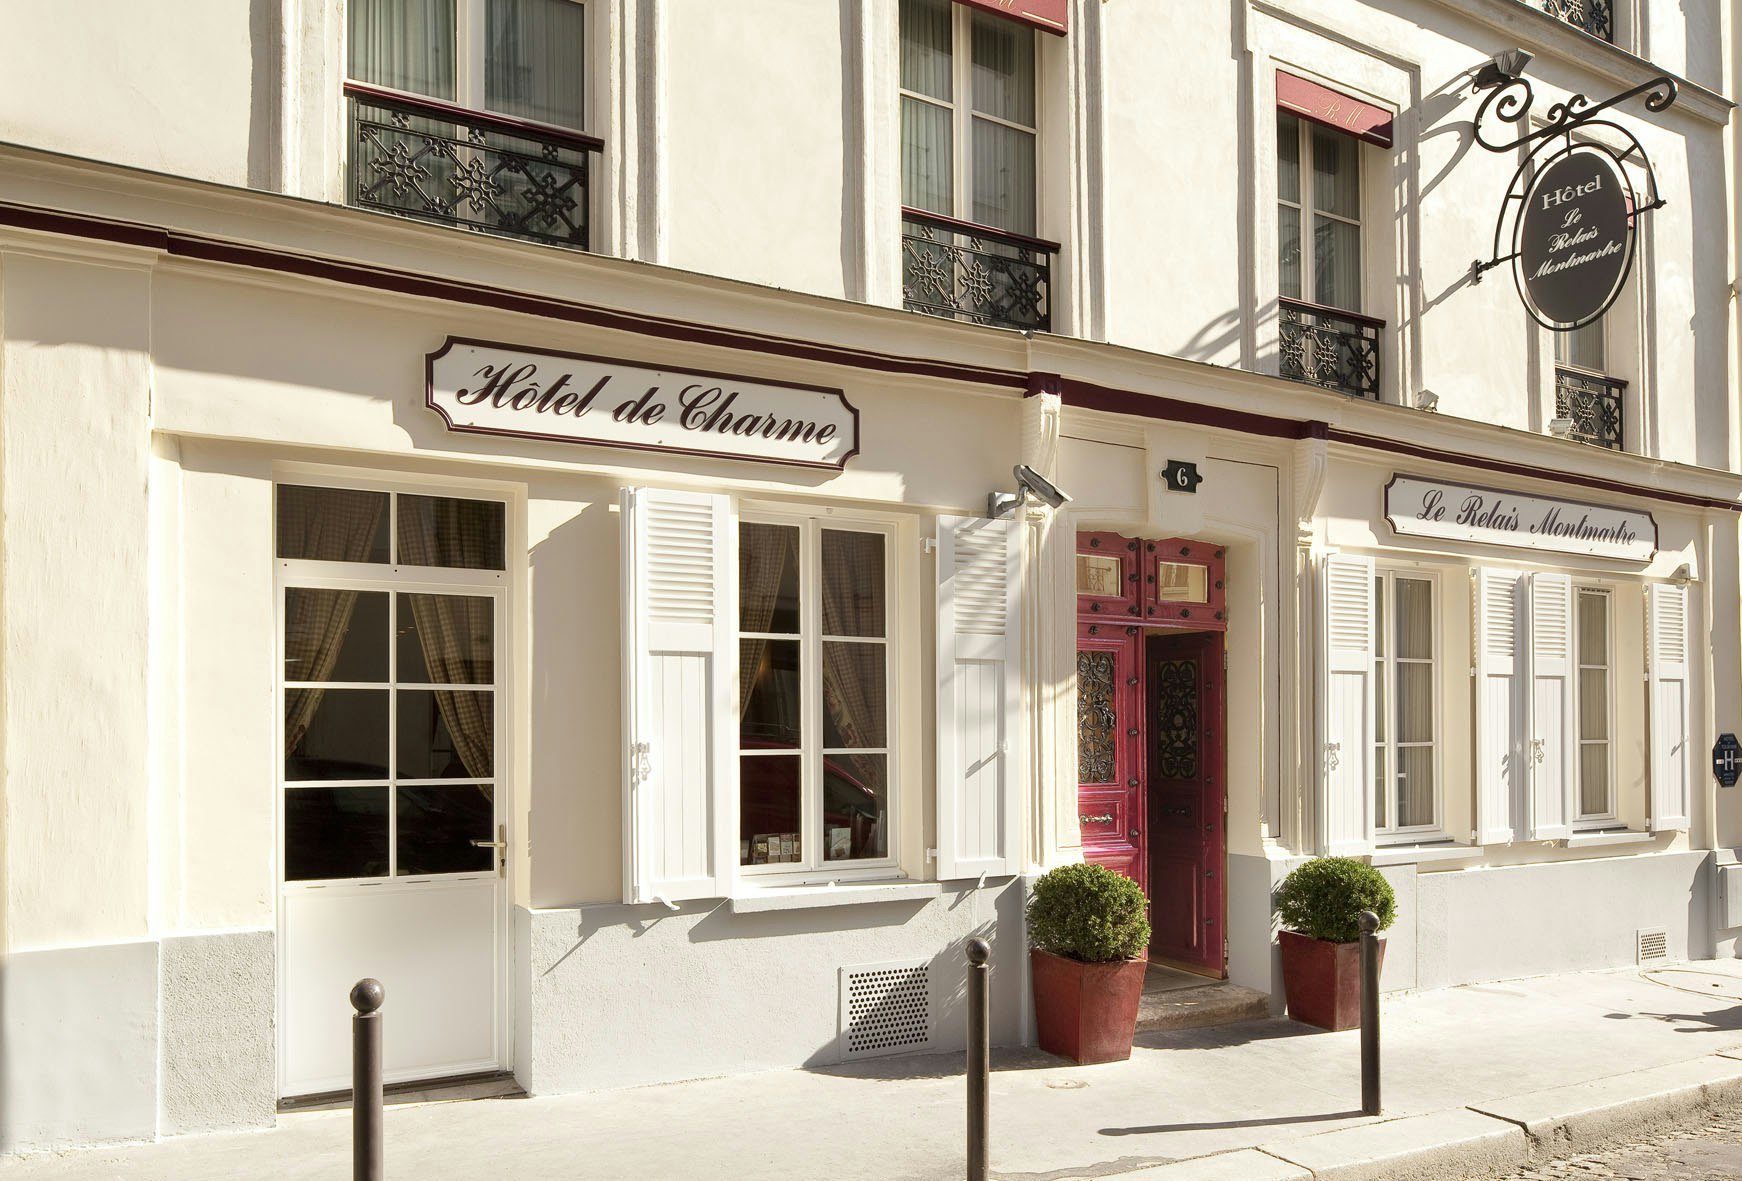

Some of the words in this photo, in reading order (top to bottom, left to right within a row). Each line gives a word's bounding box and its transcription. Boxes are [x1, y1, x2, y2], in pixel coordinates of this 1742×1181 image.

[1541, 174, 1603, 210] Hôtel
[1560, 207, 1583, 229] Le
[1548, 225, 1600, 254] Relais
[1528, 240, 1623, 281] Montmartre
[456, 362, 613, 418] Hôtel
[612, 386, 666, 426] de
[678, 384, 838, 445] Charme
[1176, 467, 1188, 487] 6
[1416, 489, 1446, 521] Le
[1456, 495, 1520, 533] Relais
[1530, 507, 1637, 546] Montmartre
[1724, 750, 1734, 771] H
